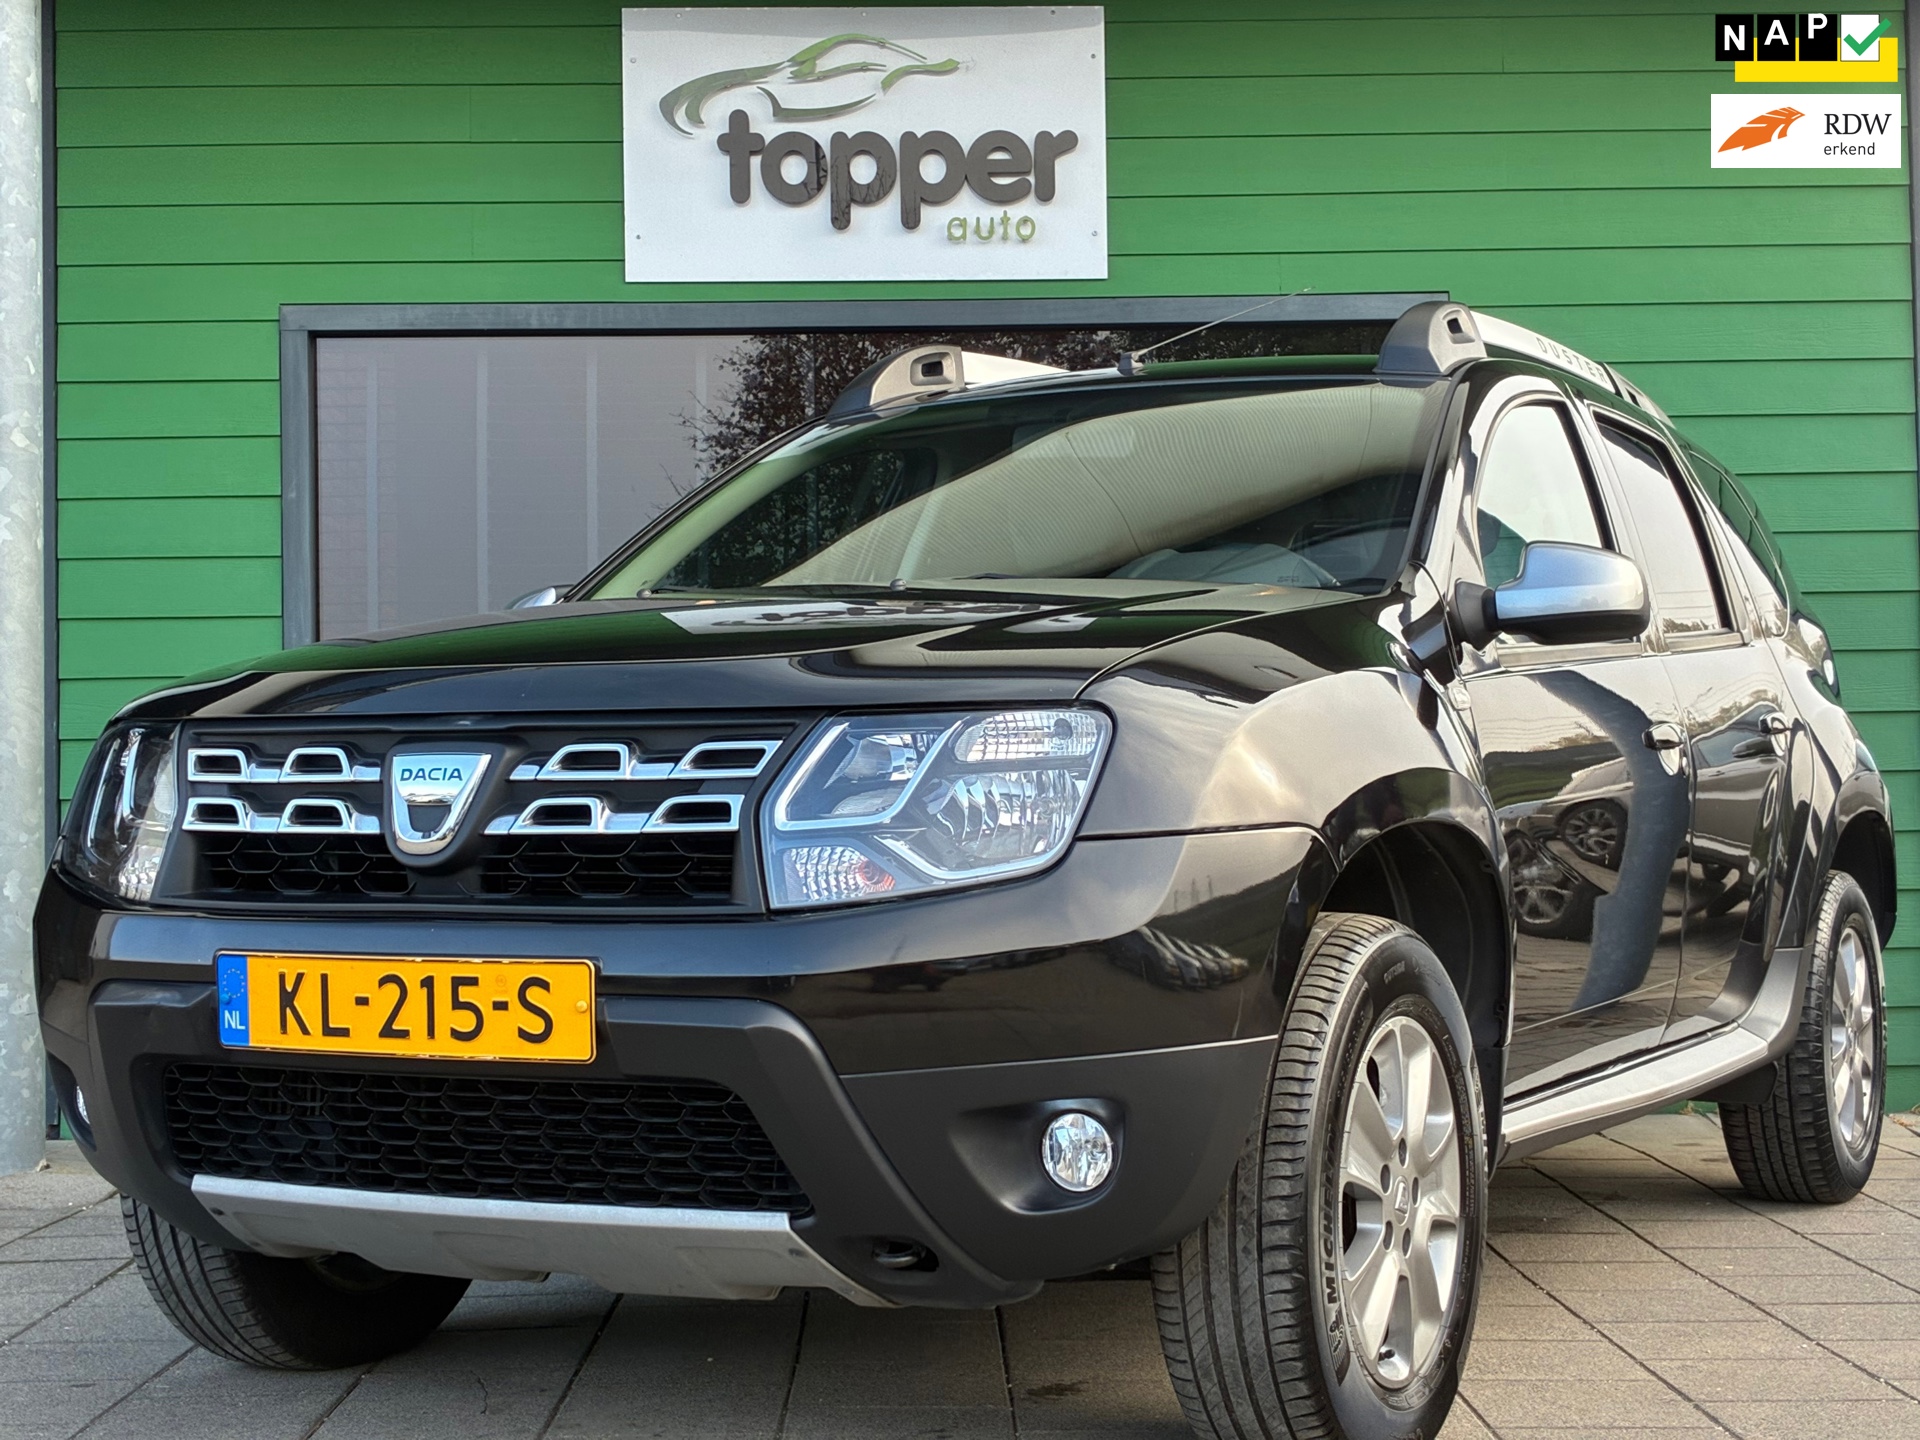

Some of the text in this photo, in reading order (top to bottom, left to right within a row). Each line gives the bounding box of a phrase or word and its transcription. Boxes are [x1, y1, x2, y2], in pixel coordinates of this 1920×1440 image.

[716, 109, 1079, 230] topper
[947, 210, 1036, 242] auto
[1536, 337, 1608, 384] DUSTER
[400, 767, 463, 781] DACIA
[225, 1010, 246, 1030] NL
[278, 971, 554, 1044] KL-215-S
[1321, 1123, 1338, 1305] MICHELIN
